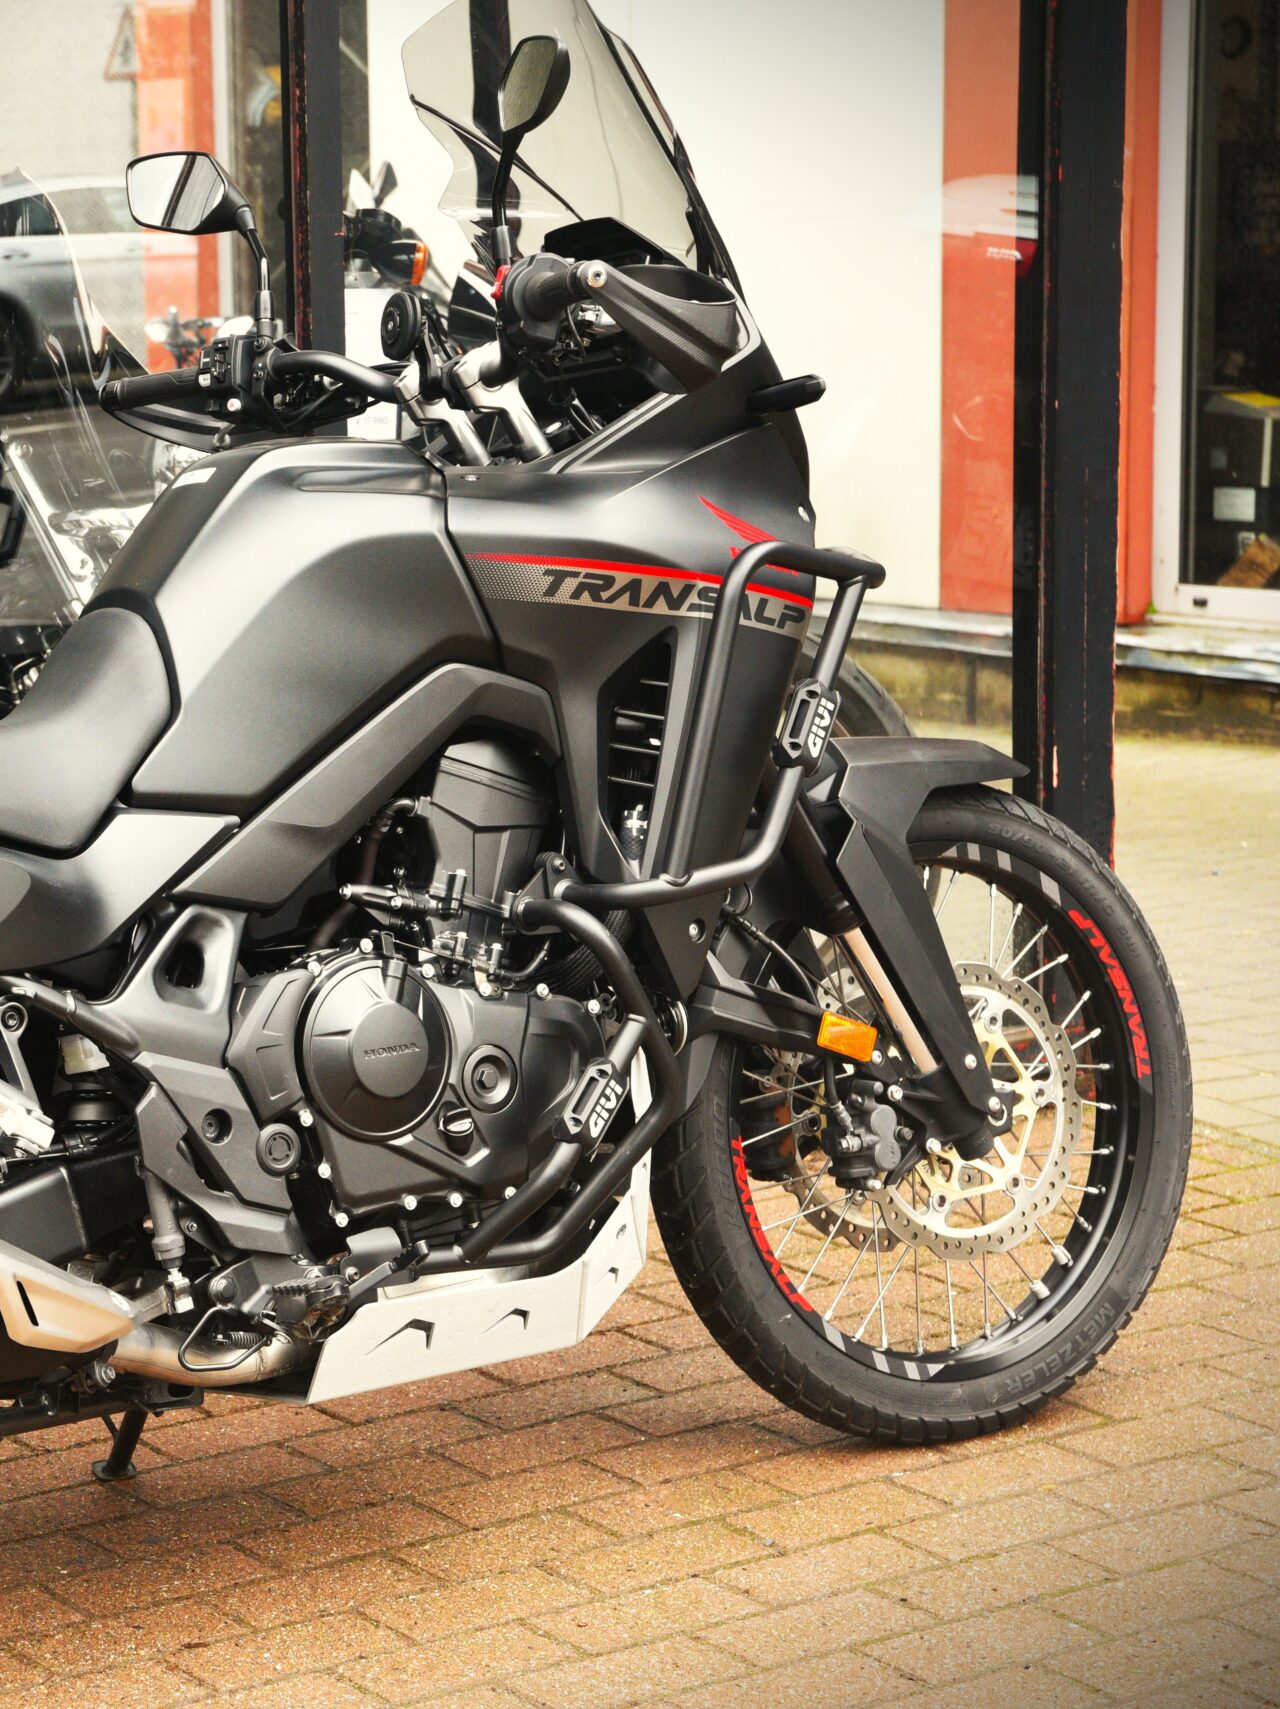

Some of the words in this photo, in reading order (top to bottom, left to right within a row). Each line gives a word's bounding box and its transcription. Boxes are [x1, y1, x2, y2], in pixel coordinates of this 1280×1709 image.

[807, 697, 835, 758] GIVI
[1068, 909, 1152, 1079] TRANSALP
[362, 1042, 421, 1060] HONDA
[589, 1079, 624, 1138] GIVI
[730, 1135, 815, 1313] TRANSALP
[1004, 1301, 1117, 1393] METZELER
